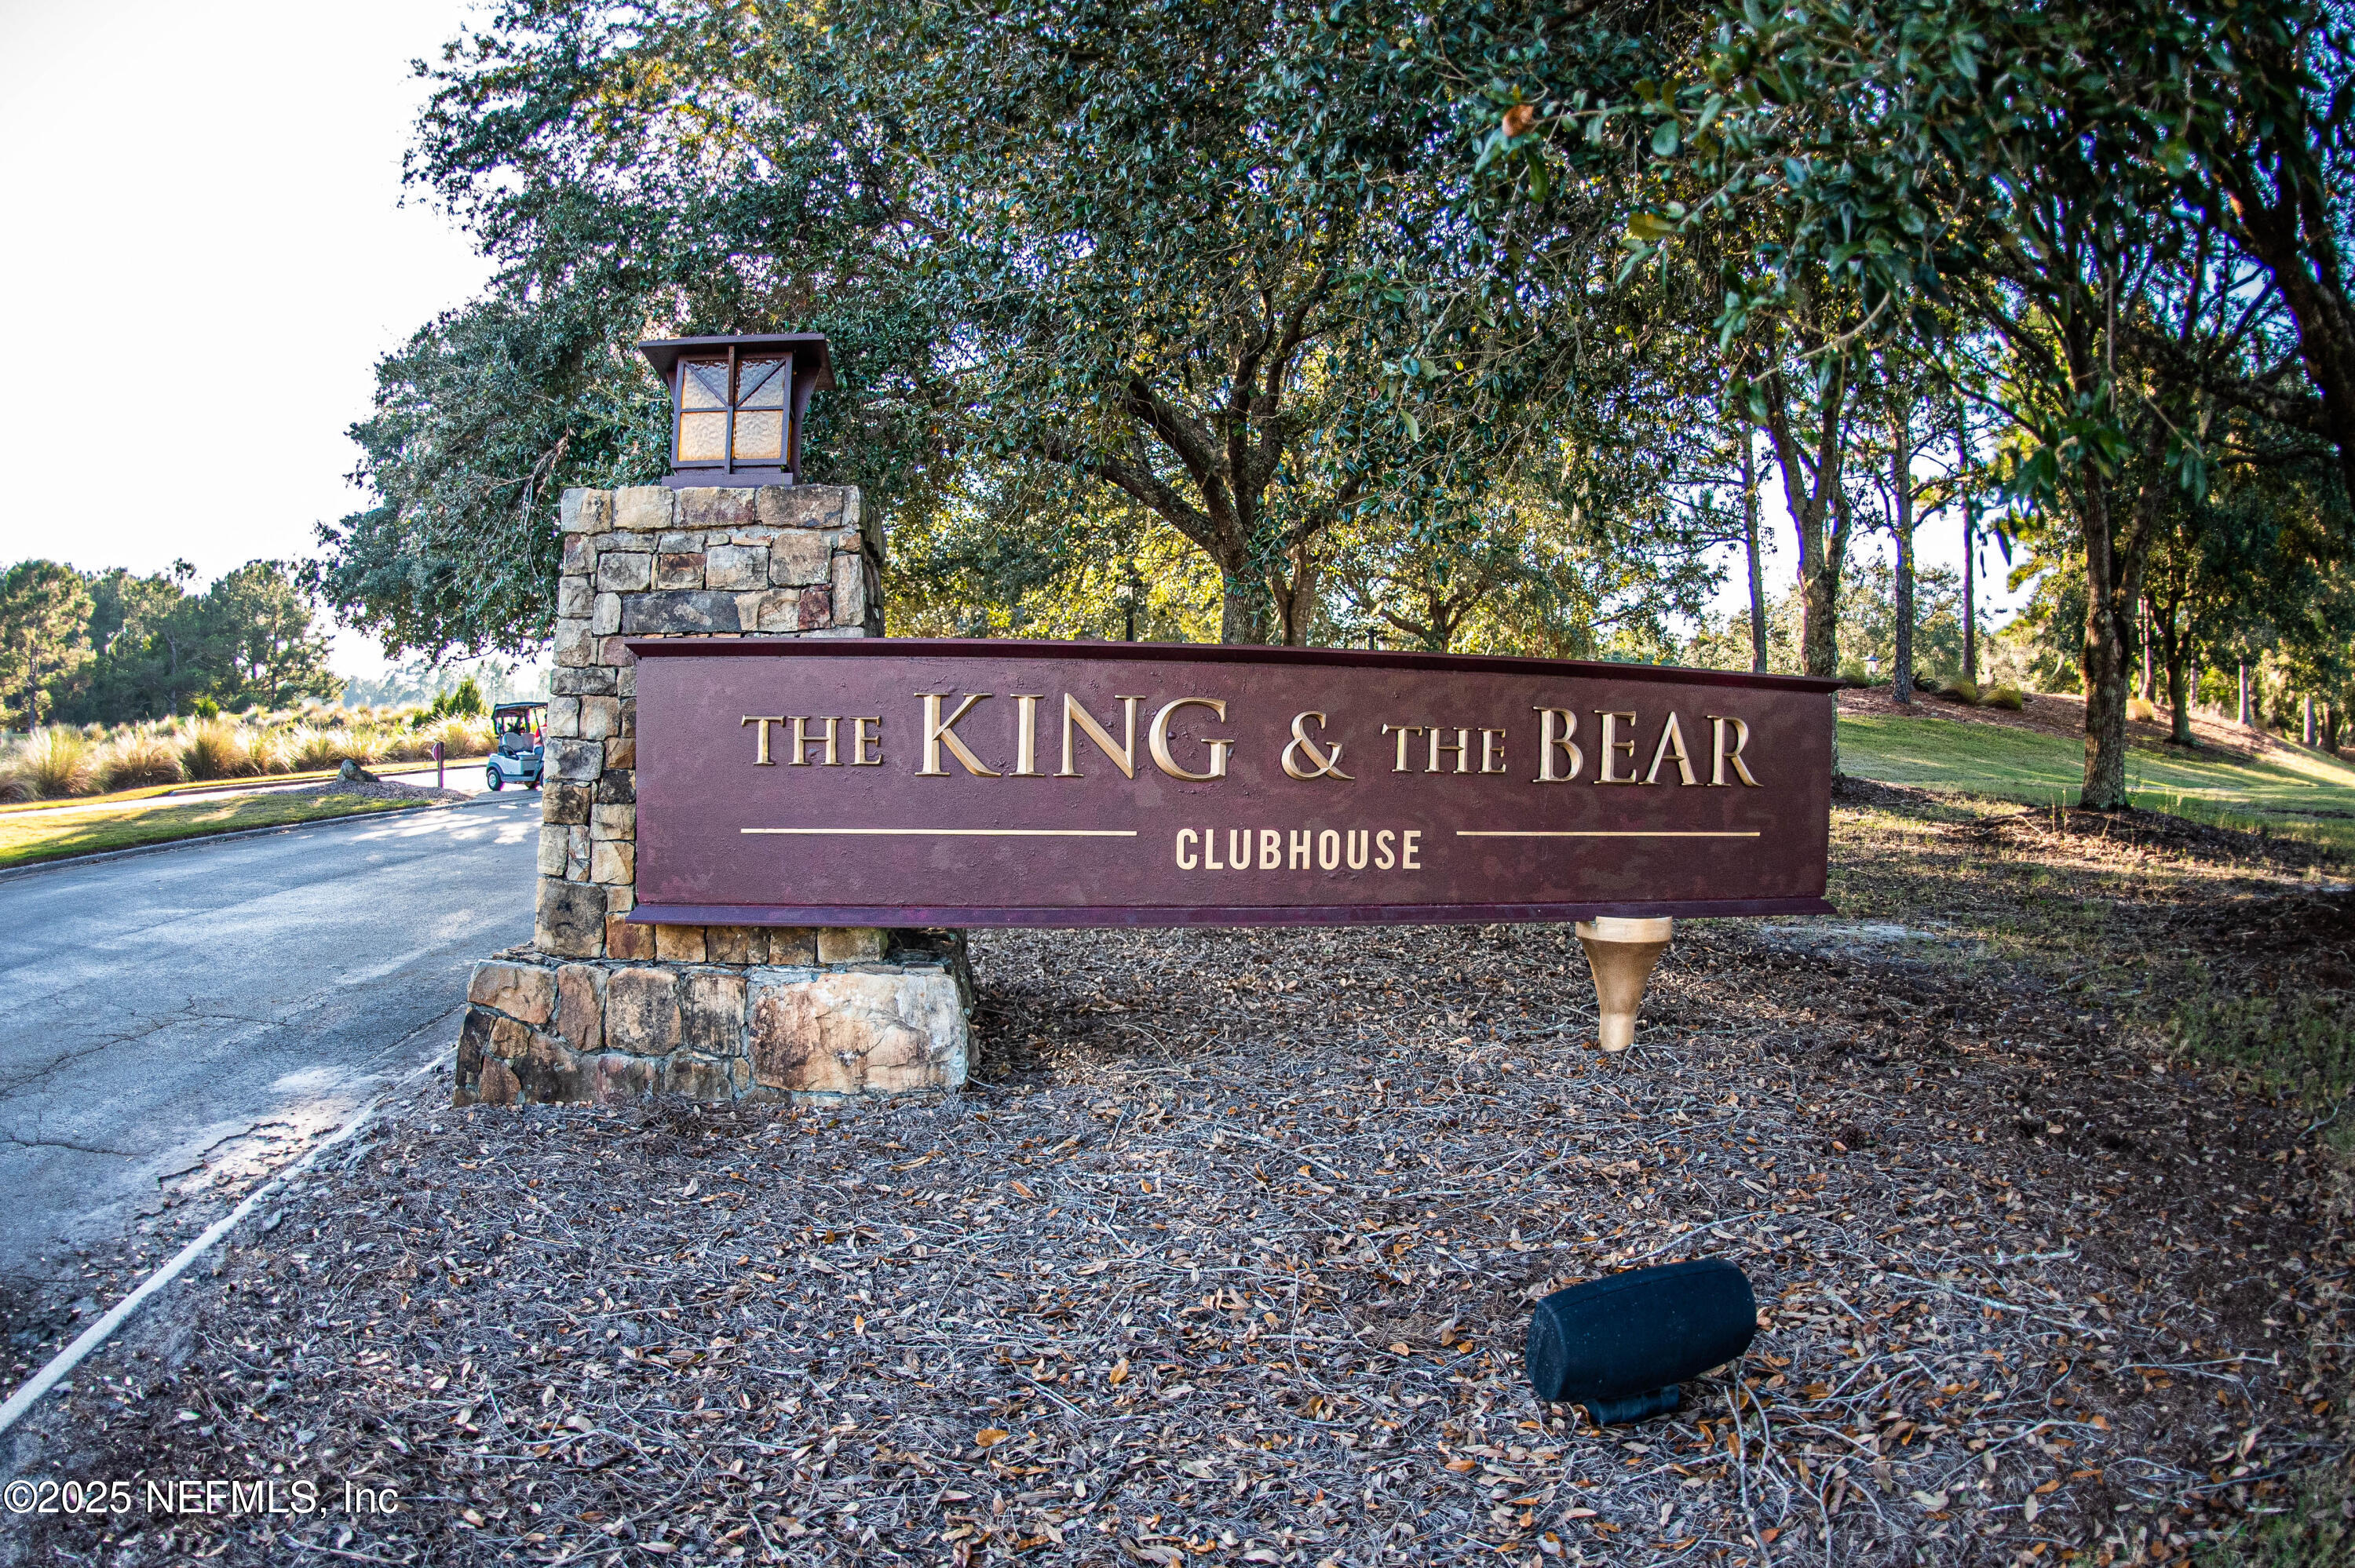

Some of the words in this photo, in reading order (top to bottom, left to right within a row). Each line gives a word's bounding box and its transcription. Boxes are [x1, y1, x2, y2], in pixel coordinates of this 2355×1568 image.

[741, 713, 884, 767] THE
[913, 692, 1235, 782] KING
[1280, 710, 1356, 782] &
[1382, 723, 1507, 774] THE
[1532, 706, 1765, 787] BEAR
[1175, 828, 1422, 870] CLUBHOUSE
